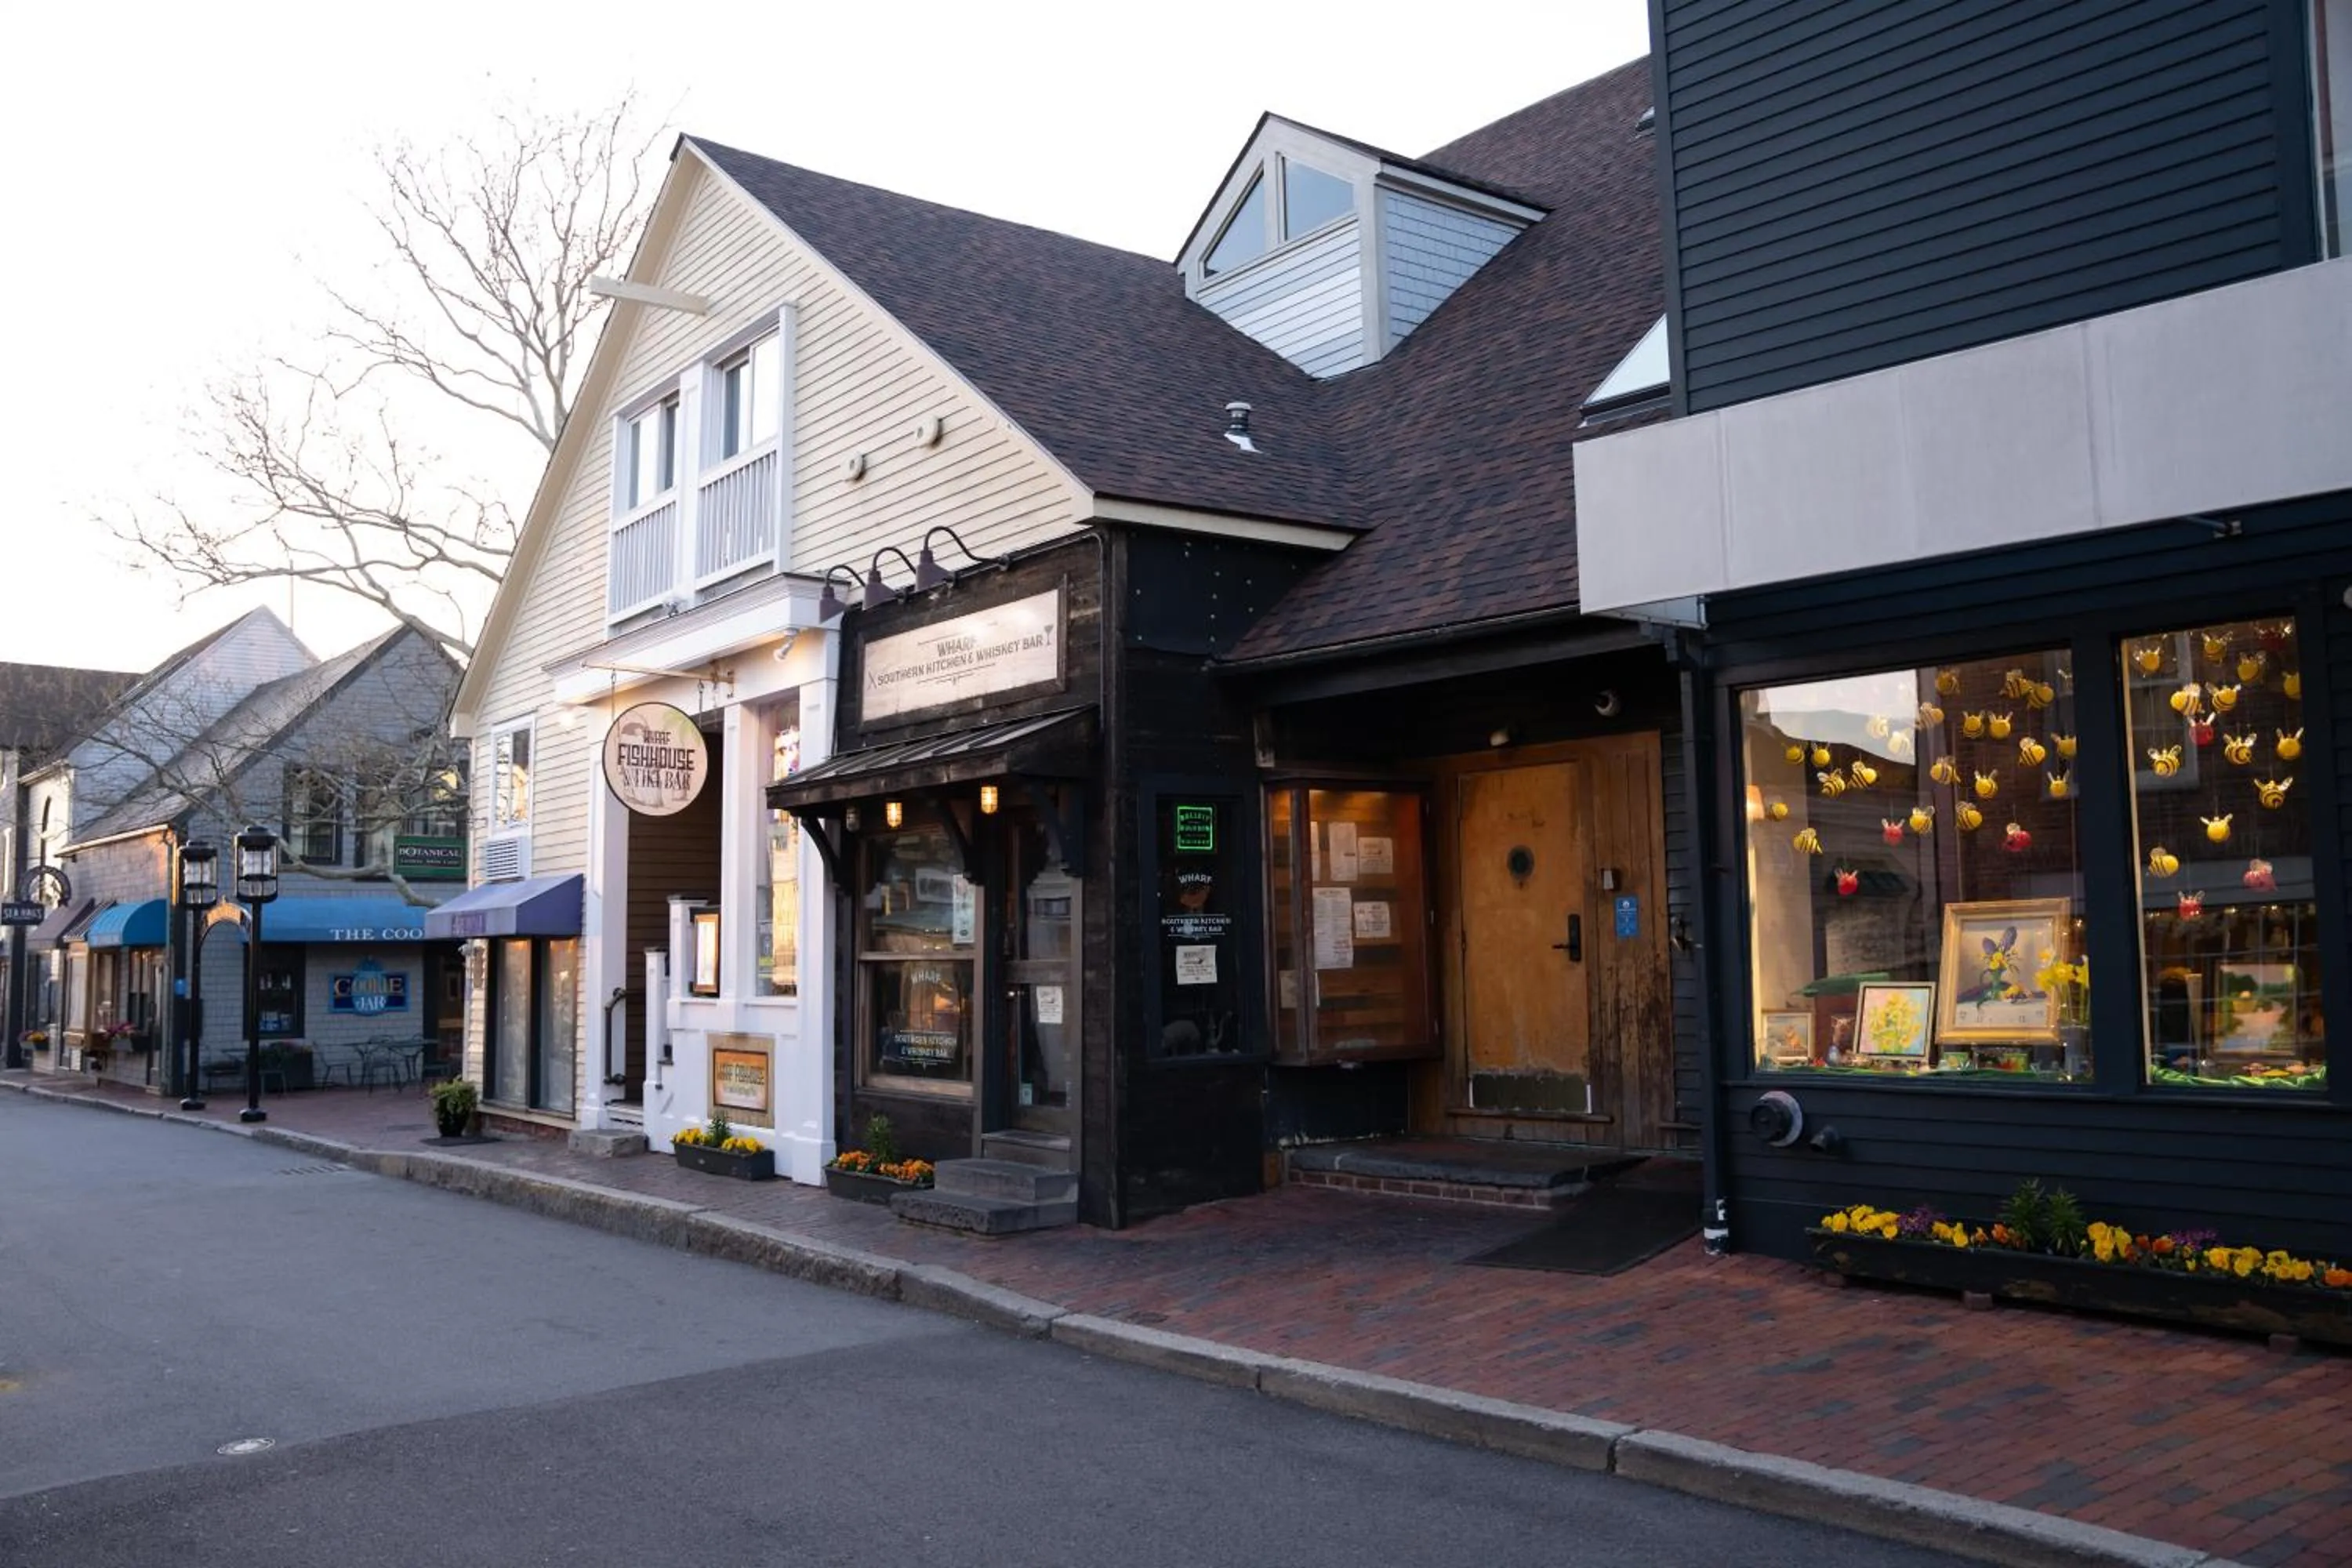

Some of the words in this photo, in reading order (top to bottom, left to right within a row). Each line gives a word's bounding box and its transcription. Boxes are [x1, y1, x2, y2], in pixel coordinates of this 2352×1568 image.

[937, 634, 978, 657] WHARF
[877, 665, 924, 686] SOUTHERN
[926, 654, 967, 675] KITCHEN
[968, 652, 974, 665] &
[976, 641, 1021, 662] WHISKEY
[1023, 633, 1044, 650] BAR
[618, 743, 695, 771] FISHHOUSE
[665, 771, 691, 790] BAR
[399, 847, 459, 857] BOTANICAL
[1179, 873, 1212, 884] WHARF
[330, 928, 375, 941] THE
[382, 928, 426, 940] COO
[911, 971, 941, 984] WHARF
[334, 978, 403, 998] COOKIE
[354, 995, 387, 1011] JAR
